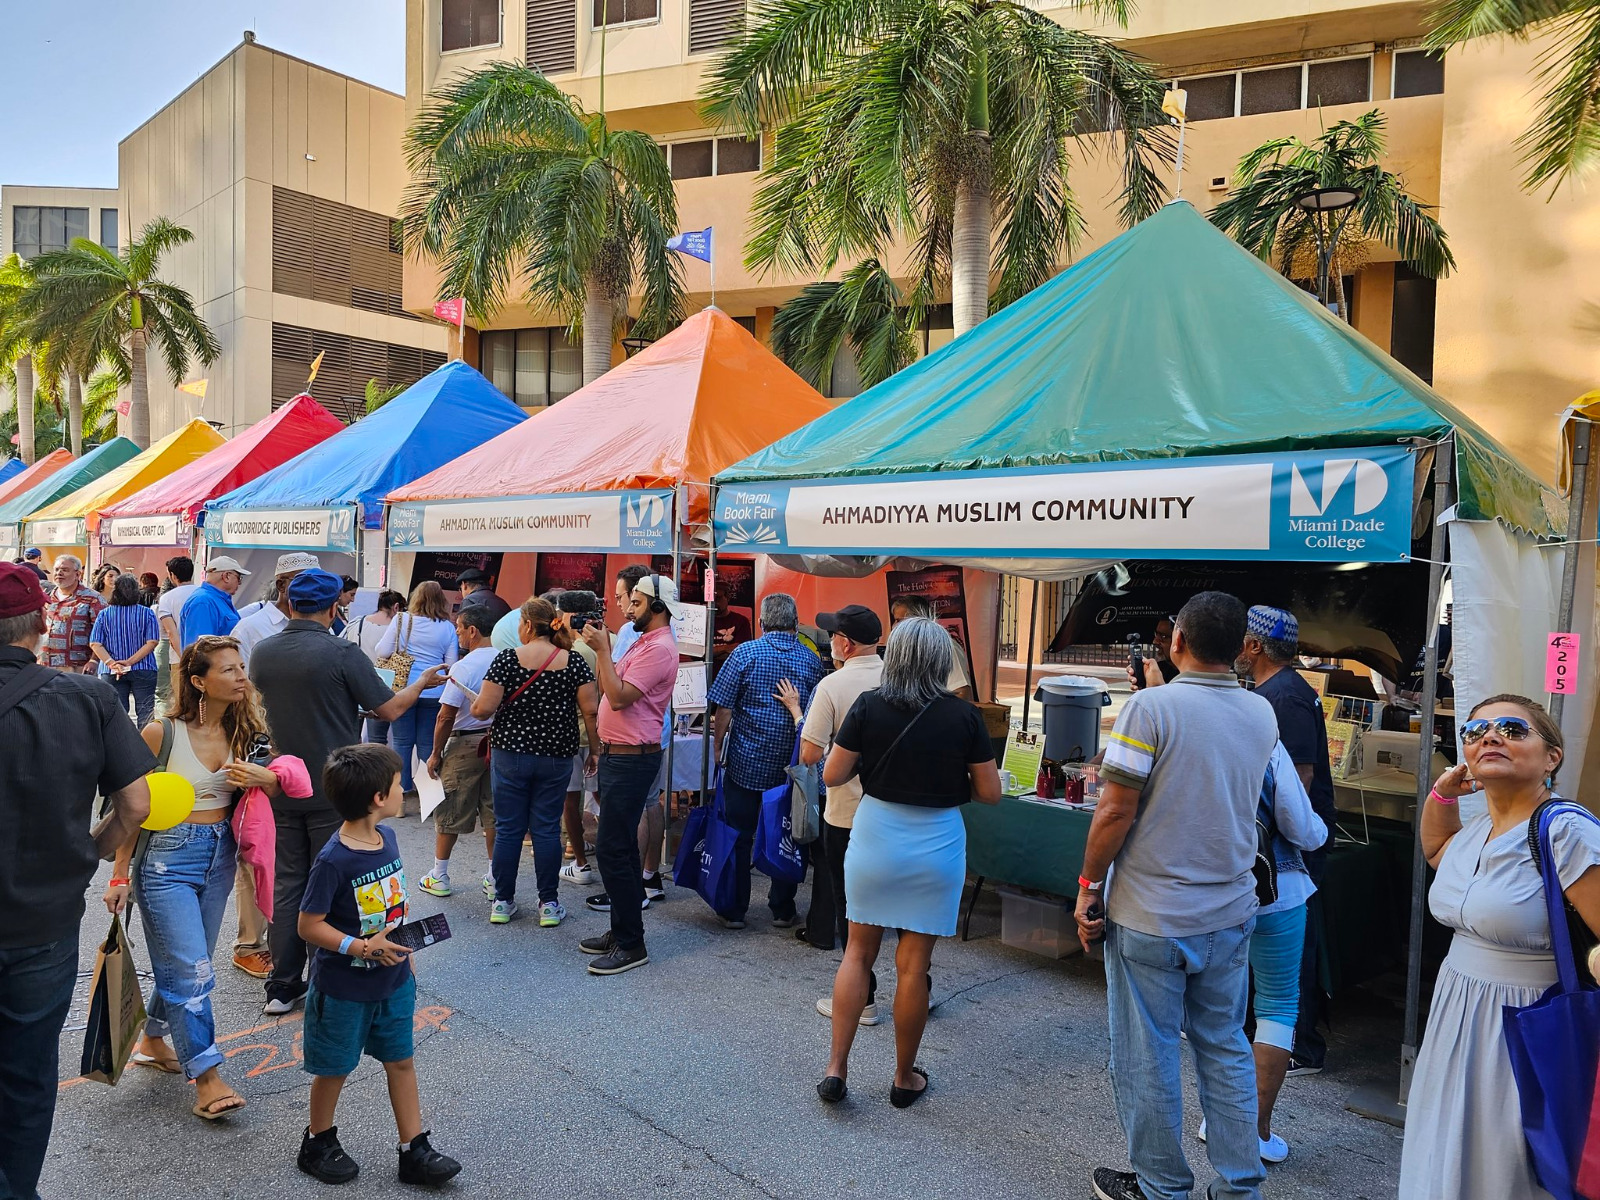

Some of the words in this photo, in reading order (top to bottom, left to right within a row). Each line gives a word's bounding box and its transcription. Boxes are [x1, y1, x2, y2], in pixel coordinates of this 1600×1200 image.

[736, 491, 771, 505] Miami
[399, 508, 416, 518] Miami
[724, 507, 752, 520] Book
[753, 505, 777, 519] Fair
[822, 504, 929, 524] AHMADIYYA
[937, 502, 1021, 522] MUSLIM
[1031, 496, 1195, 521] COMMUNITY
[227, 521, 271, 534] WOODBRIDGE
[272, 521, 321, 536] PUBLISHERS
[393, 519, 408, 529] Book
[408, 518, 420, 528] Fair
[440, 517, 486, 531] AHMADIYYA
[489, 516, 524, 530] MUSLIM
[527, 514, 592, 529] COMMUNITY
[1288, 519, 1337, 532] Miami
[1341, 518, 1385, 532] Dade
[141, 525, 156, 536] CRAFT
[157, 525, 166, 536] CO.
[626, 529, 645, 537] Miami
[646, 528, 663, 537] Dade
[632, 538, 656, 547] College
[1304, 535, 1366, 551] College
[547, 556, 559, 565] The
[897, 583, 910, 592] The
[911, 581, 929, 591] Holy
[351, 871, 376, 887] GOTTA
[376, 863, 394, 878] CATCH
